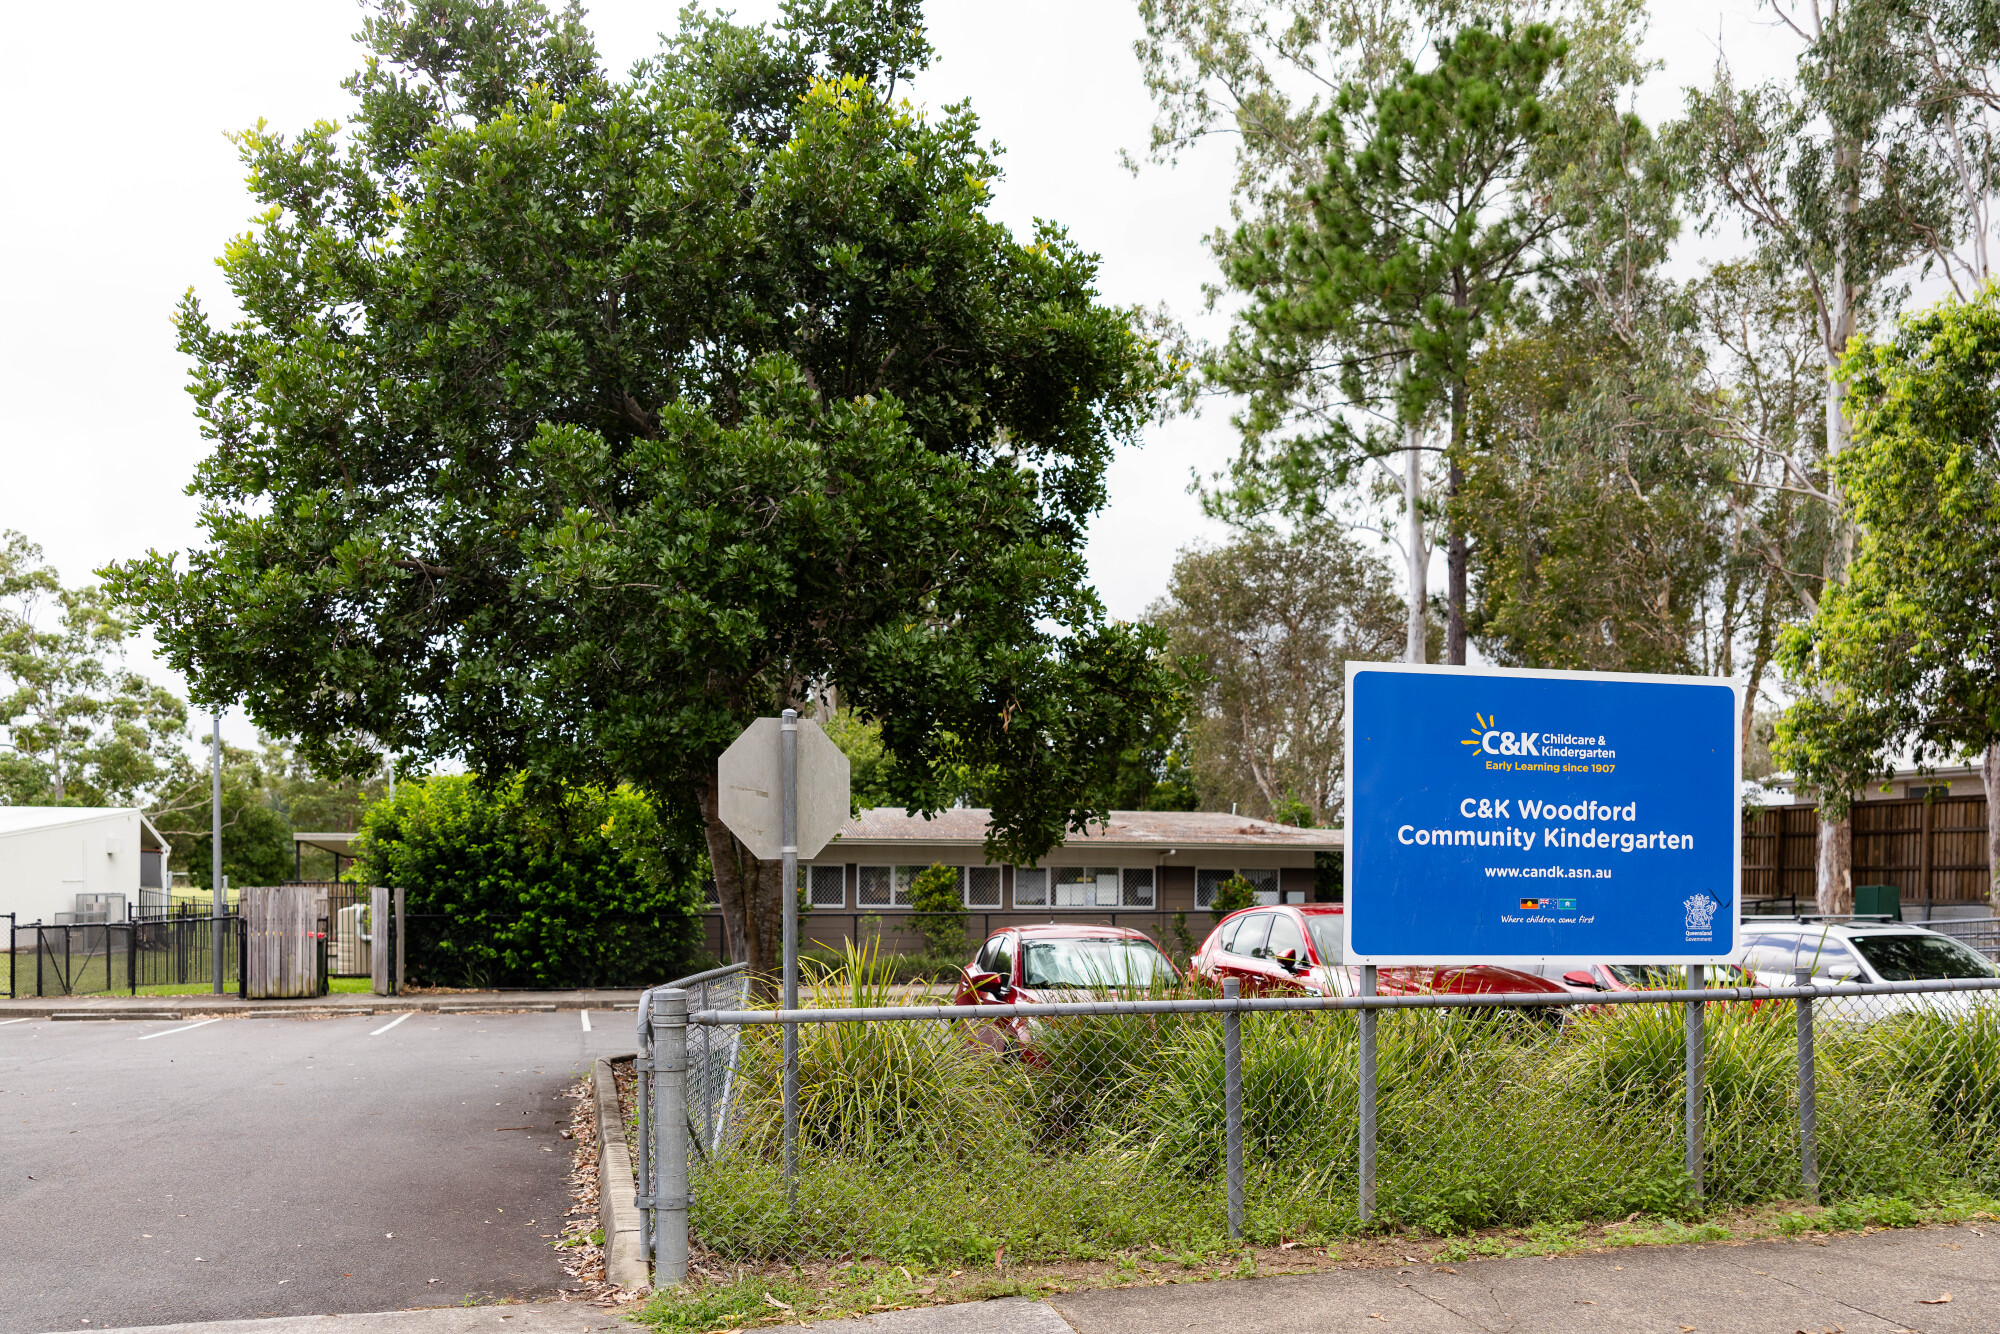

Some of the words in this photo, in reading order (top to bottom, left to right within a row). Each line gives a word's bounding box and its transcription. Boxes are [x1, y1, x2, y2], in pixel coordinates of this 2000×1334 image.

[1482, 731, 1540, 756] C&K
[1541, 734, 1596, 747] Childcare
[1597, 735, 1606, 746] &
[1541, 745, 1616, 759] Kindergarten
[1485, 760, 1512, 772] Early
[1514, 762, 1560, 774] Learning
[1562, 763, 1589, 773] since
[1590, 763, 1616, 774] 1907
[1459, 798, 1510, 819] C&K
[1517, 799, 1636, 821] Woodford
[1397, 824, 1536, 851] Community
[1543, 827, 1694, 853] Kindergarten
[1484, 865, 1612, 879] www.candk.asn.au
[1501, 914, 1524, 923] Where
[1526, 914, 1556, 924] children
[1578, 914, 1595, 924] first
